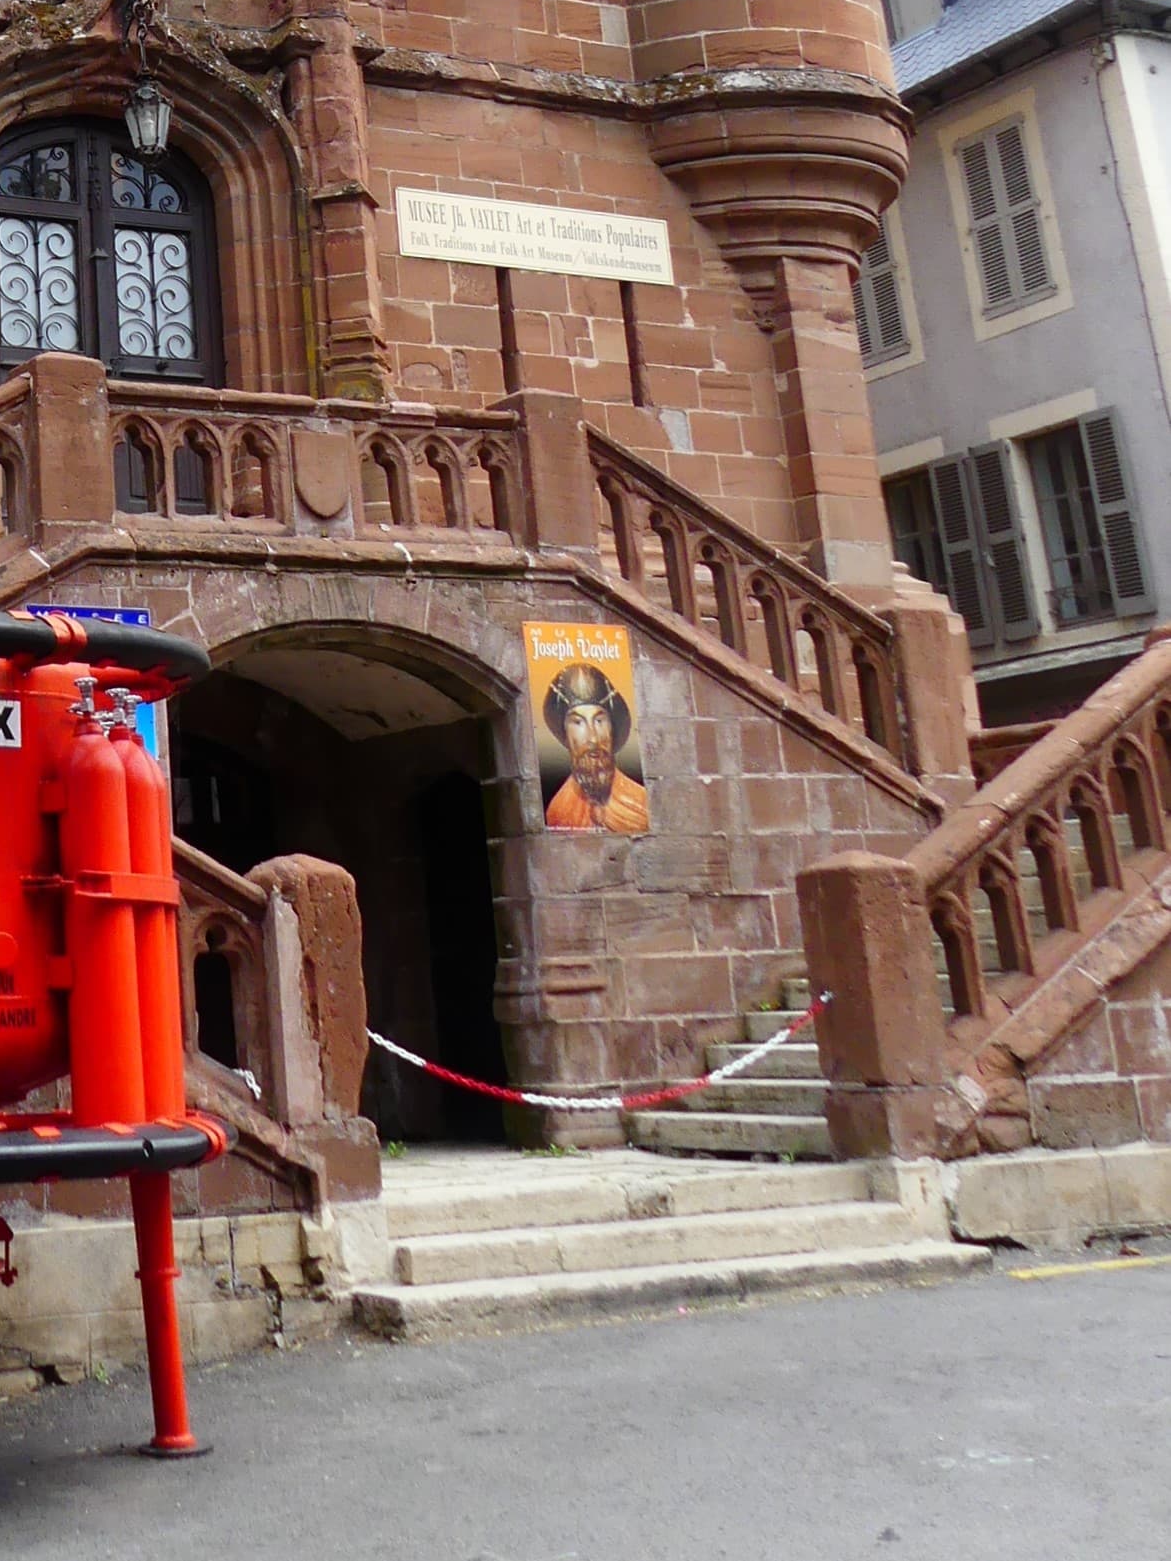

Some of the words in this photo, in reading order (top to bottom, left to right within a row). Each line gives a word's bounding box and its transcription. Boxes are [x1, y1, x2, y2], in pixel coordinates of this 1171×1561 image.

[408, 199, 447, 225] MUSEE
[451, 205, 467, 233] Jh.
[470, 207, 511, 233] VAYLET
[516, 213, 532, 236] Art
[536, 220, 546, 237] et
[550, 217, 603, 243] Traditions
[606, 223, 658, 253] Populaires
[411, 231, 430, 246] Folk
[434, 233, 478, 253] Traditions
[481, 240, 497, 254] and
[500, 241, 519, 257] Folk
[532, 636, 574, 661] Joseph
[576, 638, 620, 662] Vaylet
